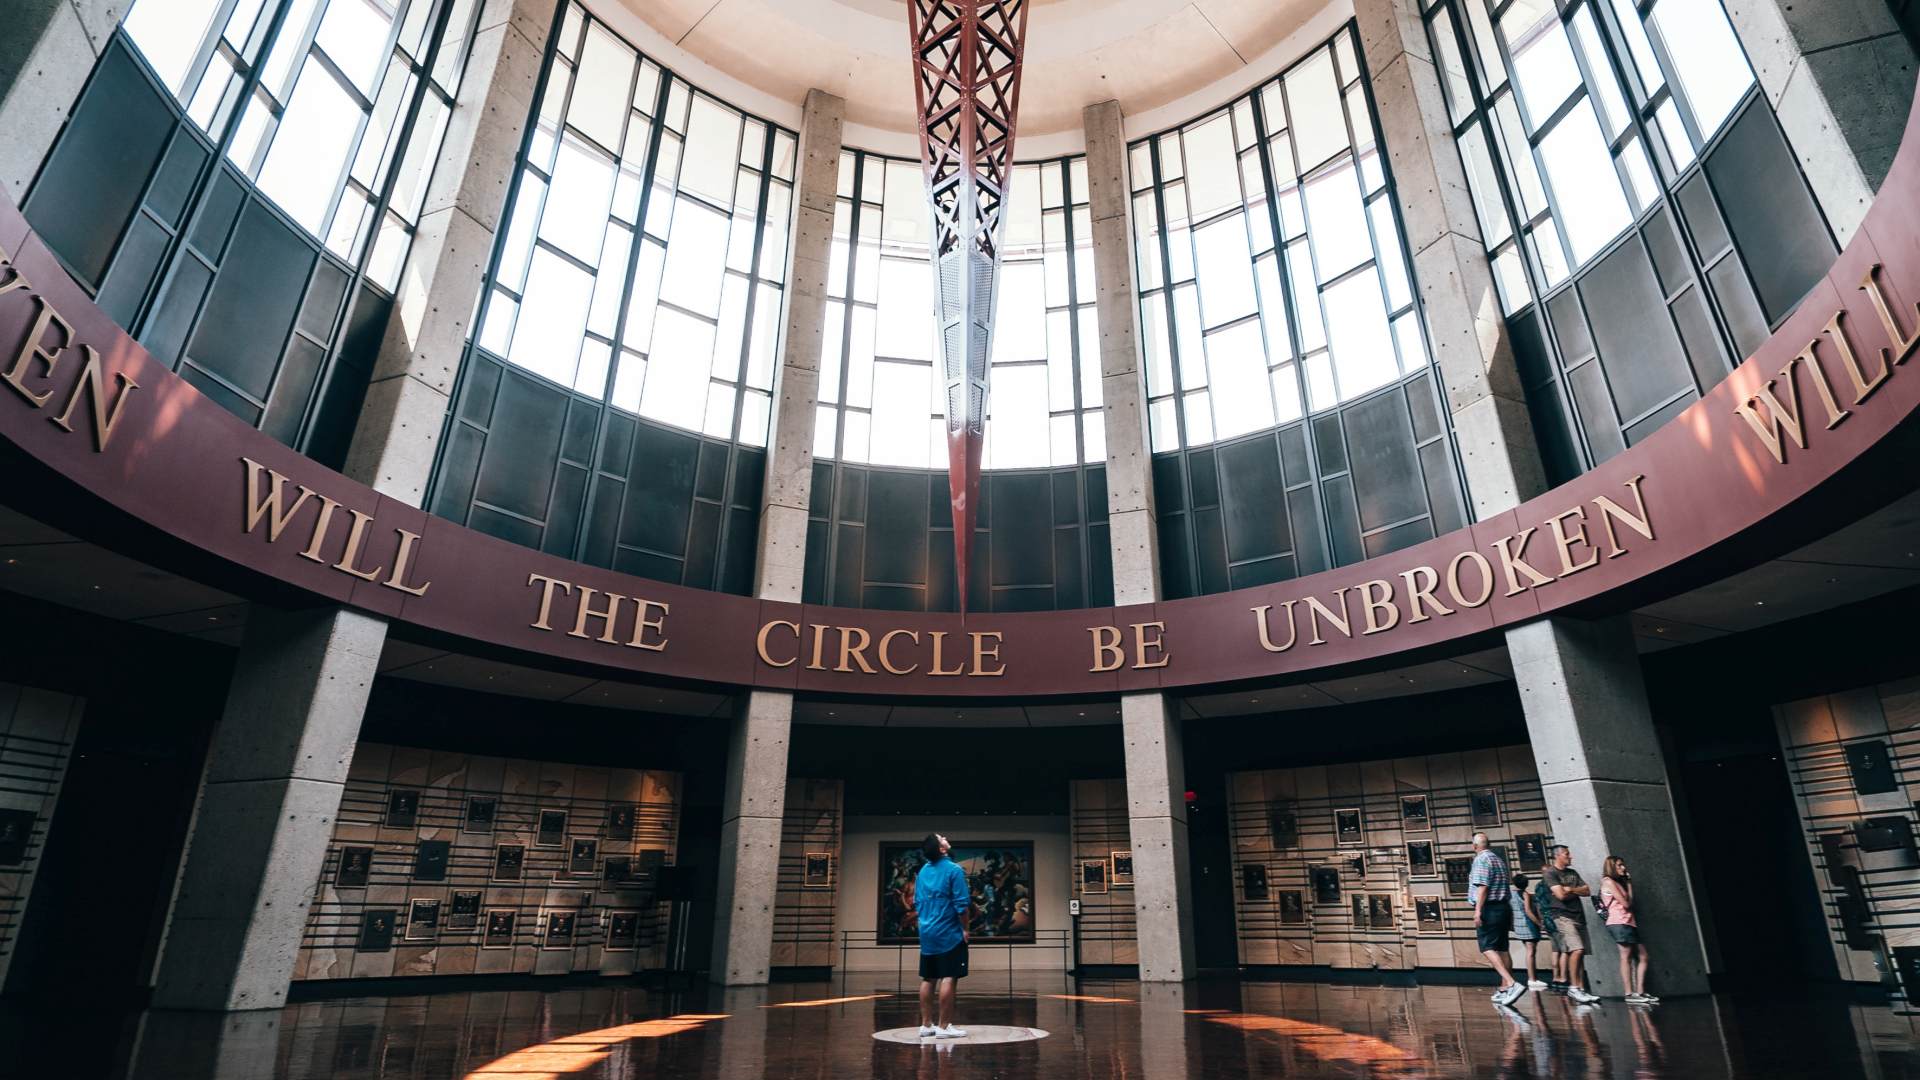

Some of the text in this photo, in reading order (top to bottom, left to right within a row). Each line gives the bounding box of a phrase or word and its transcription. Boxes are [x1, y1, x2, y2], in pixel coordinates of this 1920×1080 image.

[240, 456, 431, 597] WILL
[527, 573, 669, 653] THE
[755, 619, 1007, 677] CIRCLE
[1088, 620, 1171, 673] BE
[1250, 474, 1655, 653] UNBROKEN
[1732, 263, 1920, 465] WILL
